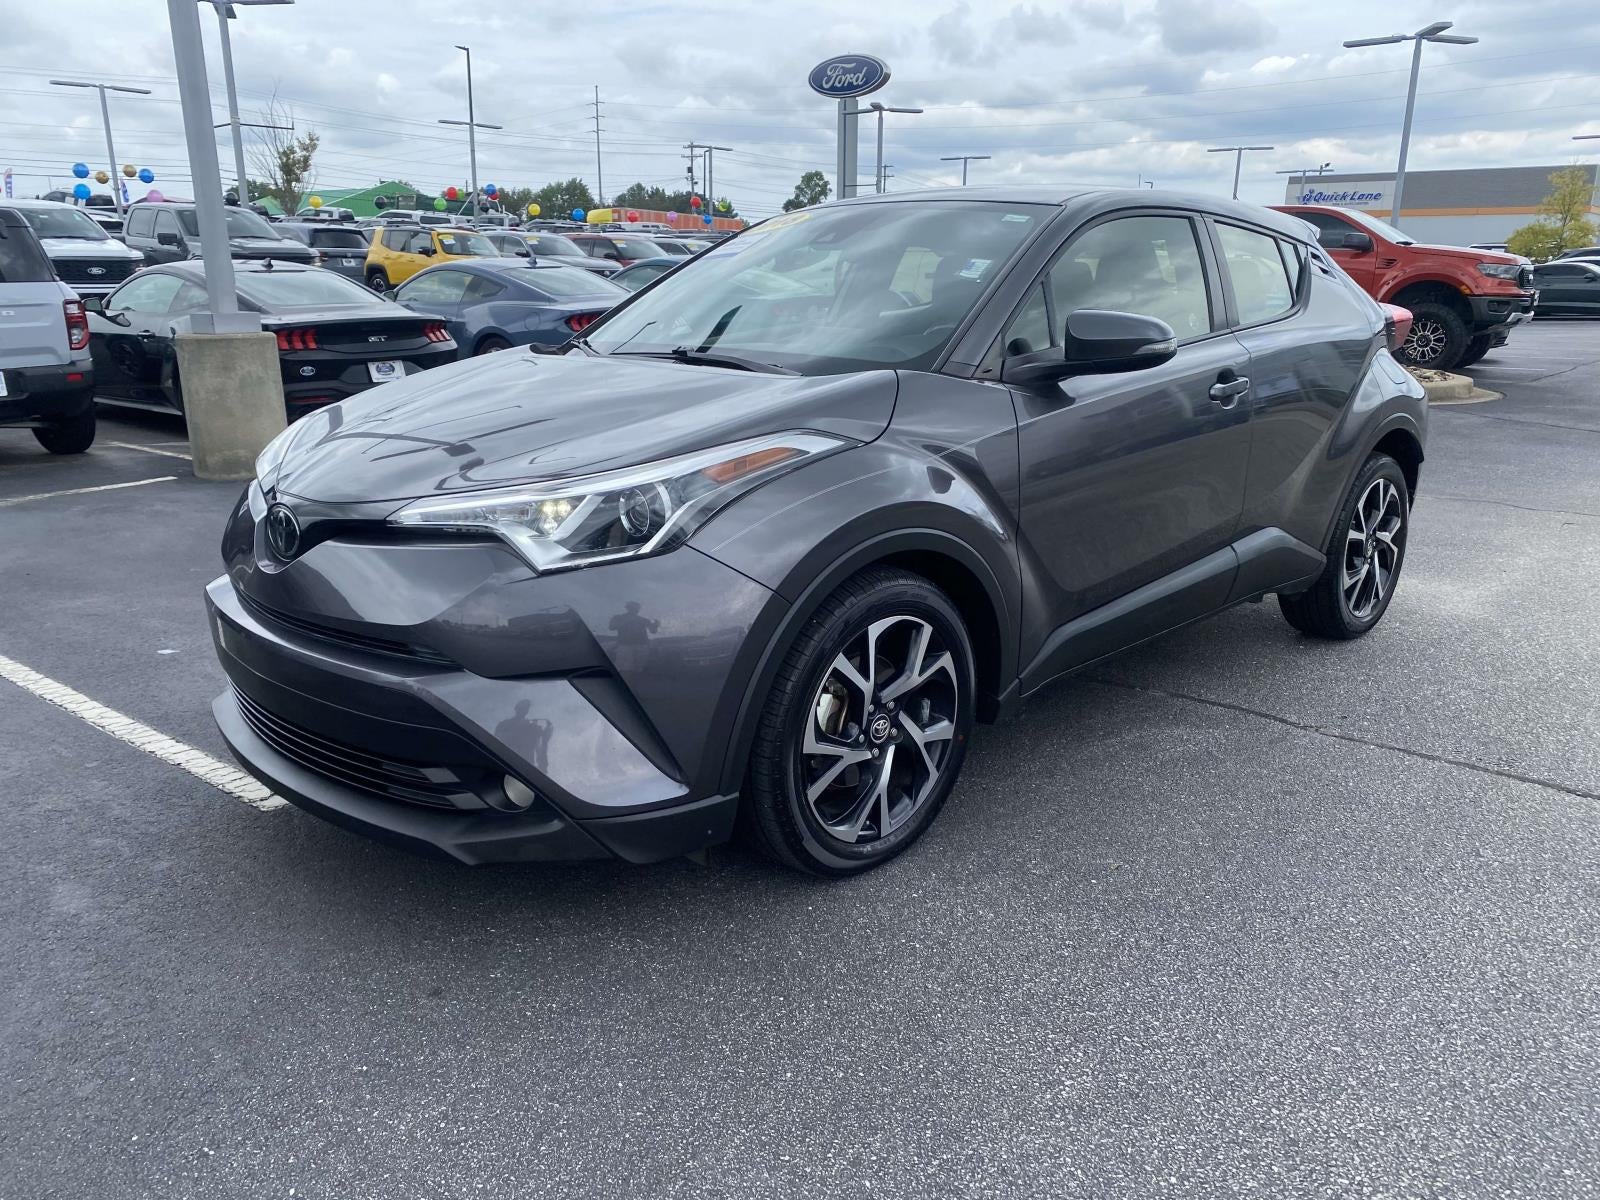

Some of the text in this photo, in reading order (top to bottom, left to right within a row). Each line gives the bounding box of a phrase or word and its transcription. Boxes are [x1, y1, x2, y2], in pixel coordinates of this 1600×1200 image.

[822, 63, 867, 88] Ford
[1313, 191, 1383, 203] Quick Lane
